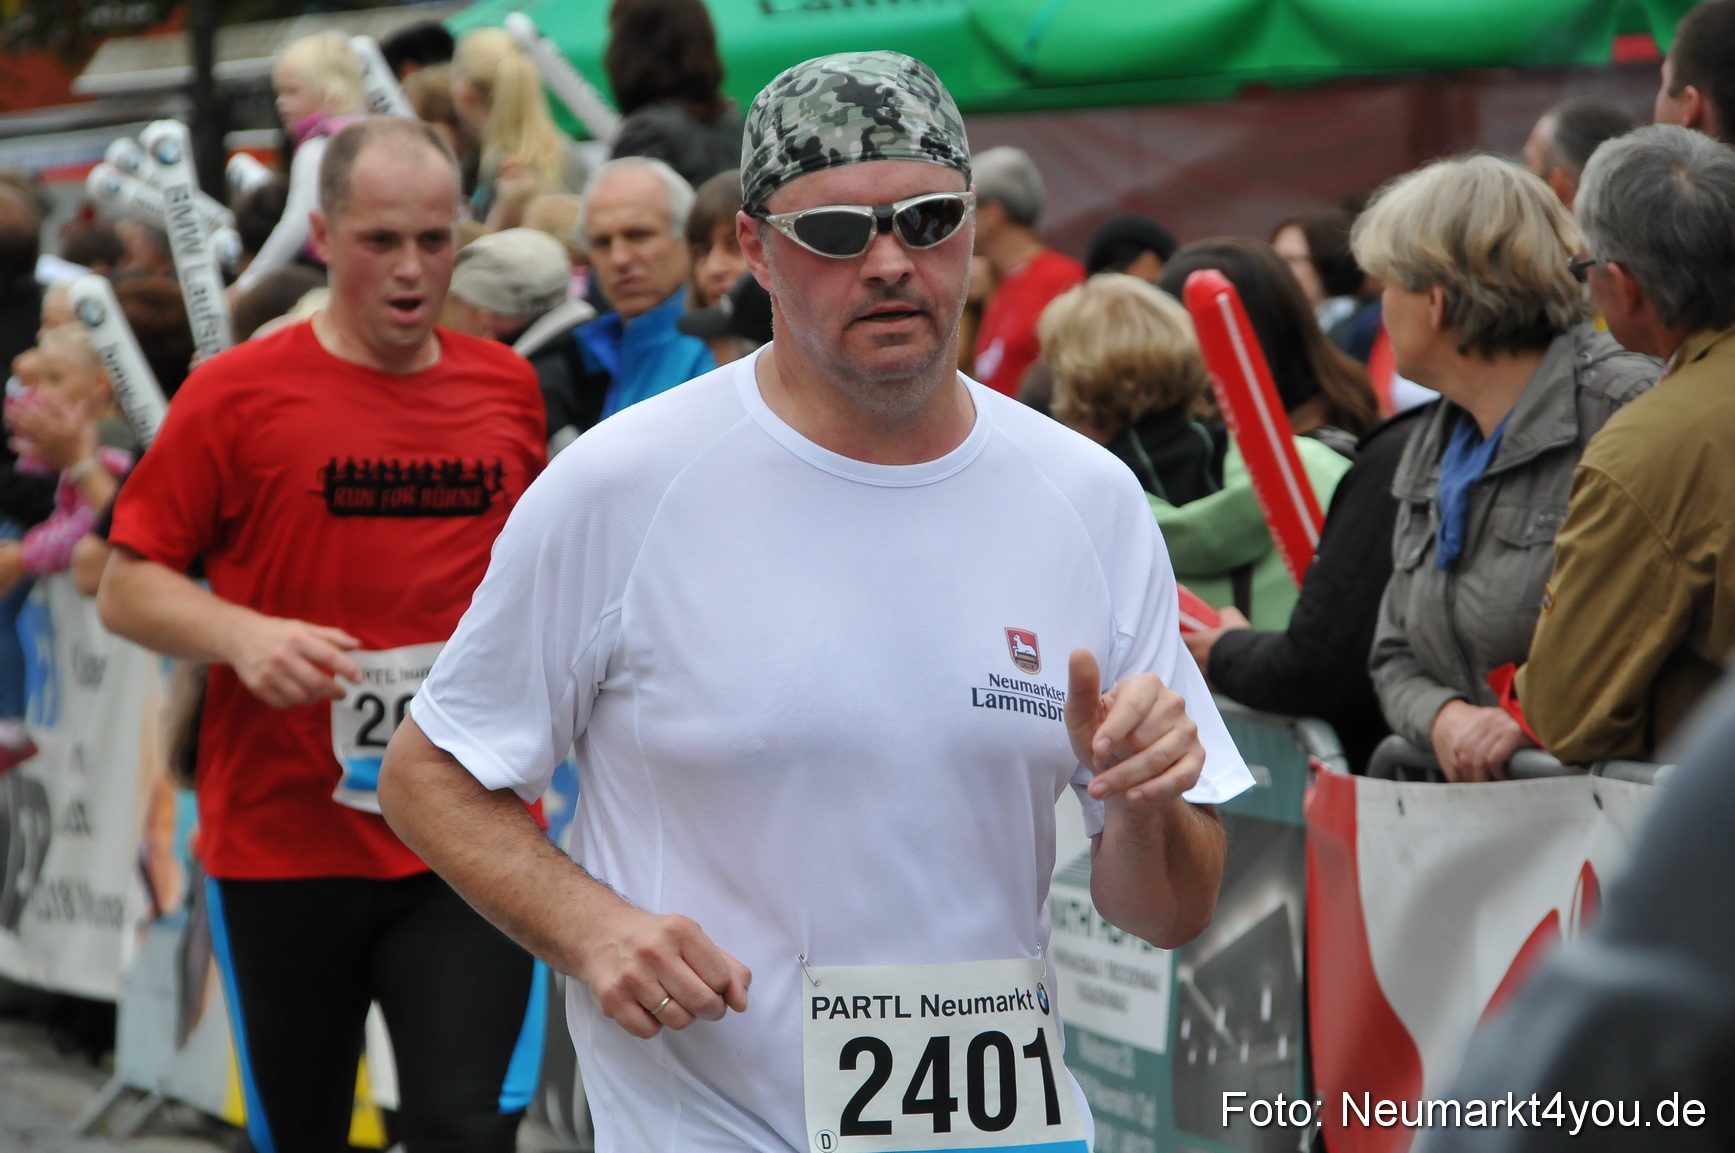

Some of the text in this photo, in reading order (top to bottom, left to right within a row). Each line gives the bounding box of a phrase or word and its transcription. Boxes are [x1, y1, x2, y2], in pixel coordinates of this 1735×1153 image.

[988, 672, 1066, 702] Neumarkter
[971, 687, 1064, 722] Lammsbr
[811, 988, 1035, 1020] PARTL Neumarkt
[838, 1027, 1062, 1137] 2401
